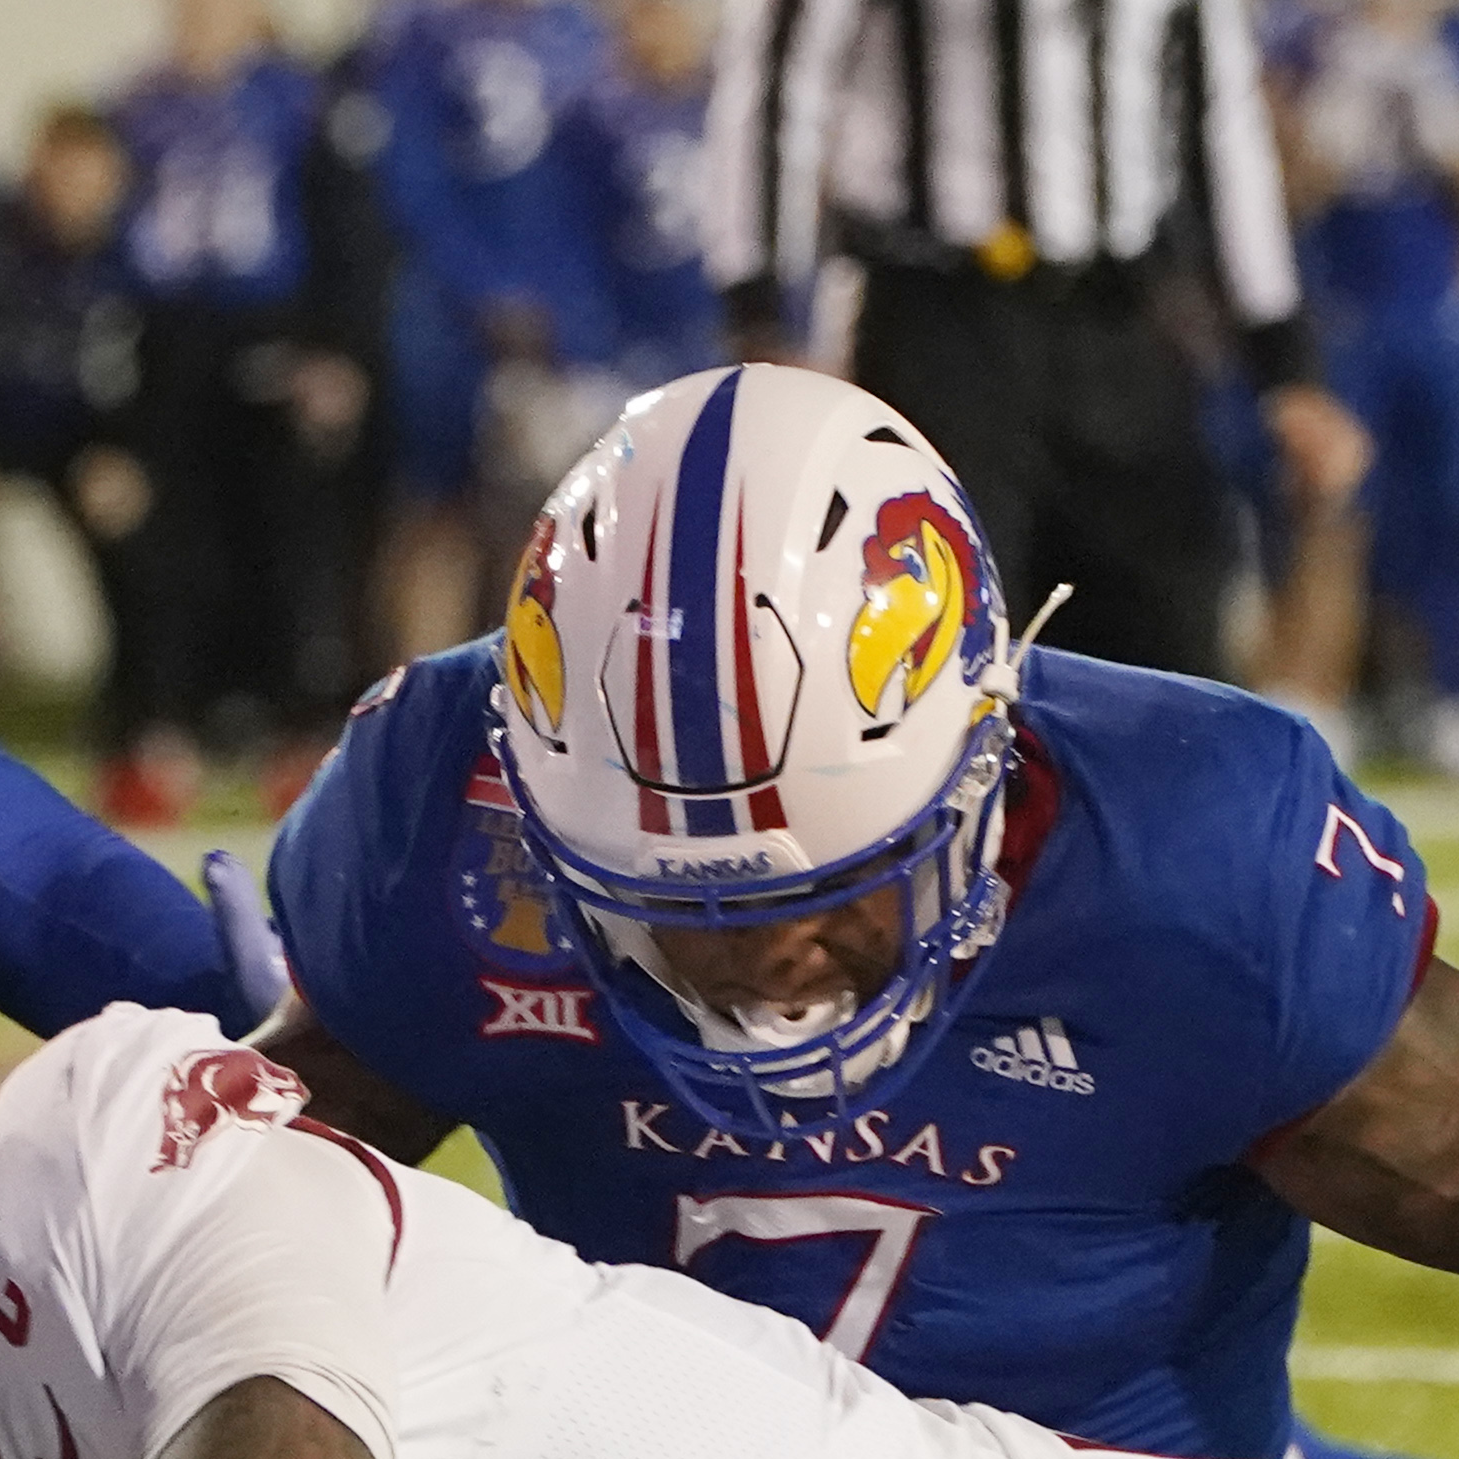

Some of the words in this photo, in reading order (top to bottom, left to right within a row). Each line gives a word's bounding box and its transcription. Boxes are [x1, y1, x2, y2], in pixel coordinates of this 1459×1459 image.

[478, 979, 596, 1042] XII
[970, 1045, 1096, 1096] adidas
[673, 1192, 945, 1365] 7
